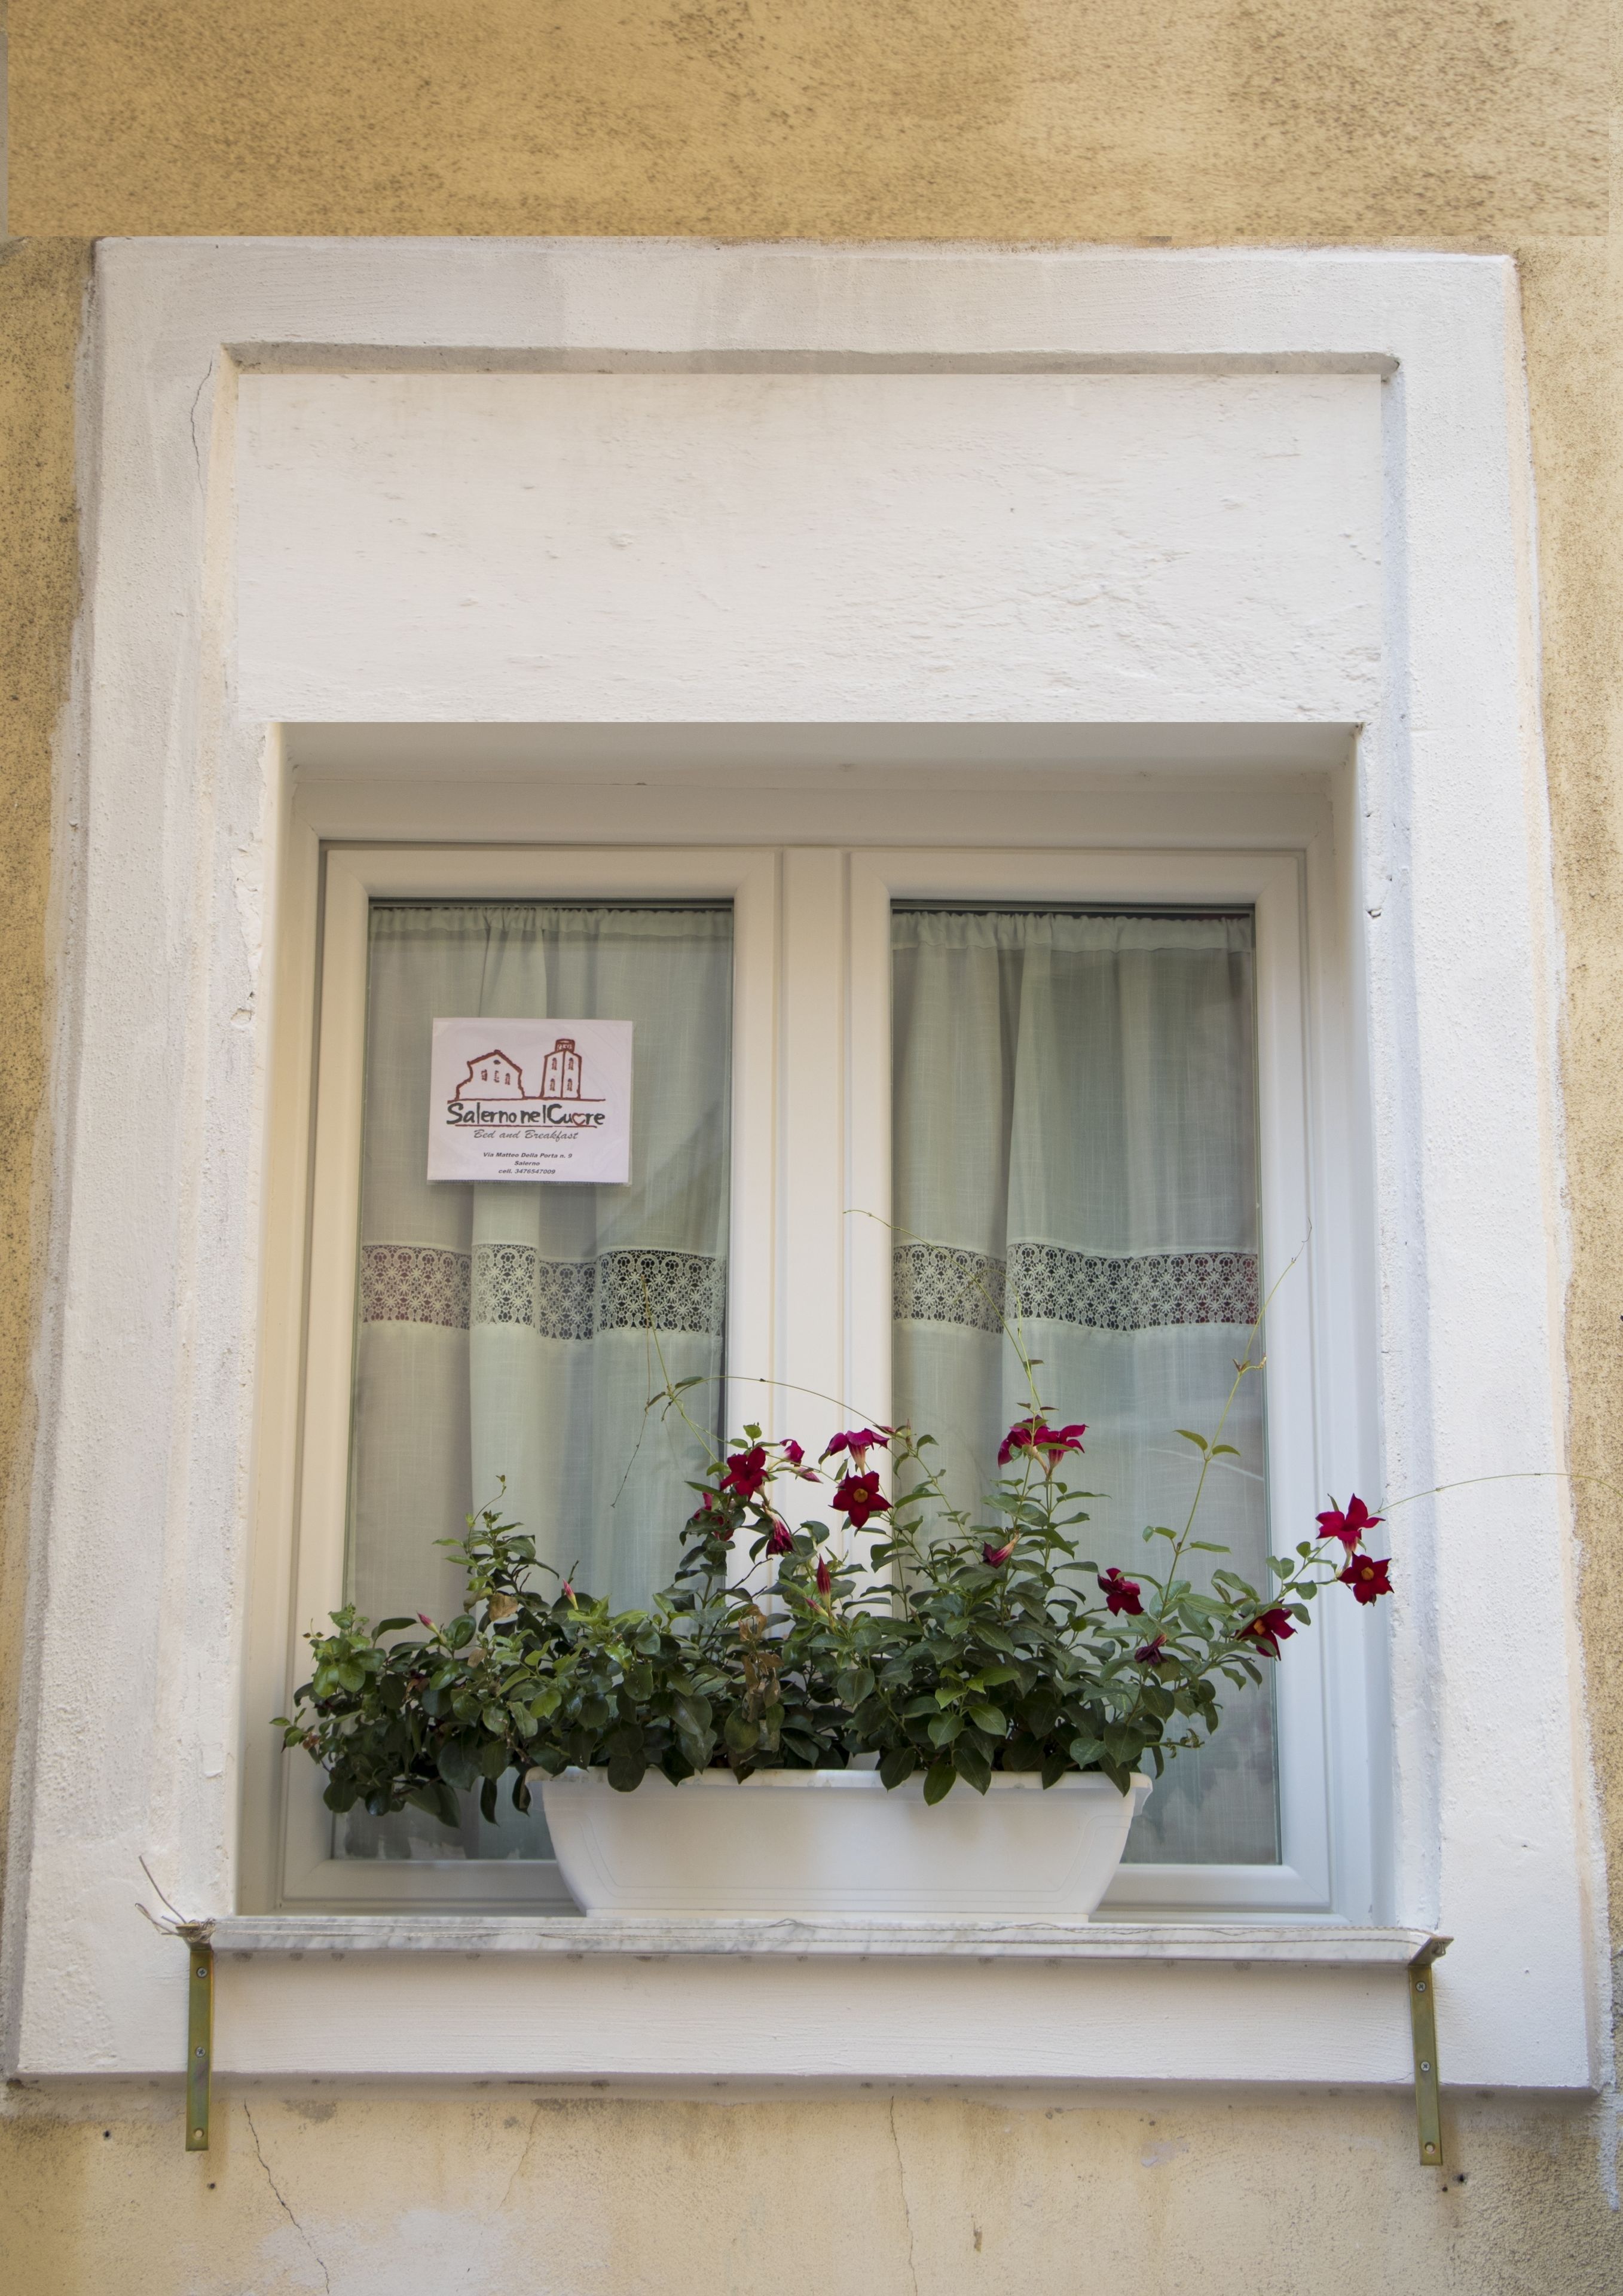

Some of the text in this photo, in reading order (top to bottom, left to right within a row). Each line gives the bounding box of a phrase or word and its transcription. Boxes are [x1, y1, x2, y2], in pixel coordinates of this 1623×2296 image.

[447, 1102, 606, 1126] Salerno nel Cuore
[473, 1129, 579, 1142] Bed and Breakfast
